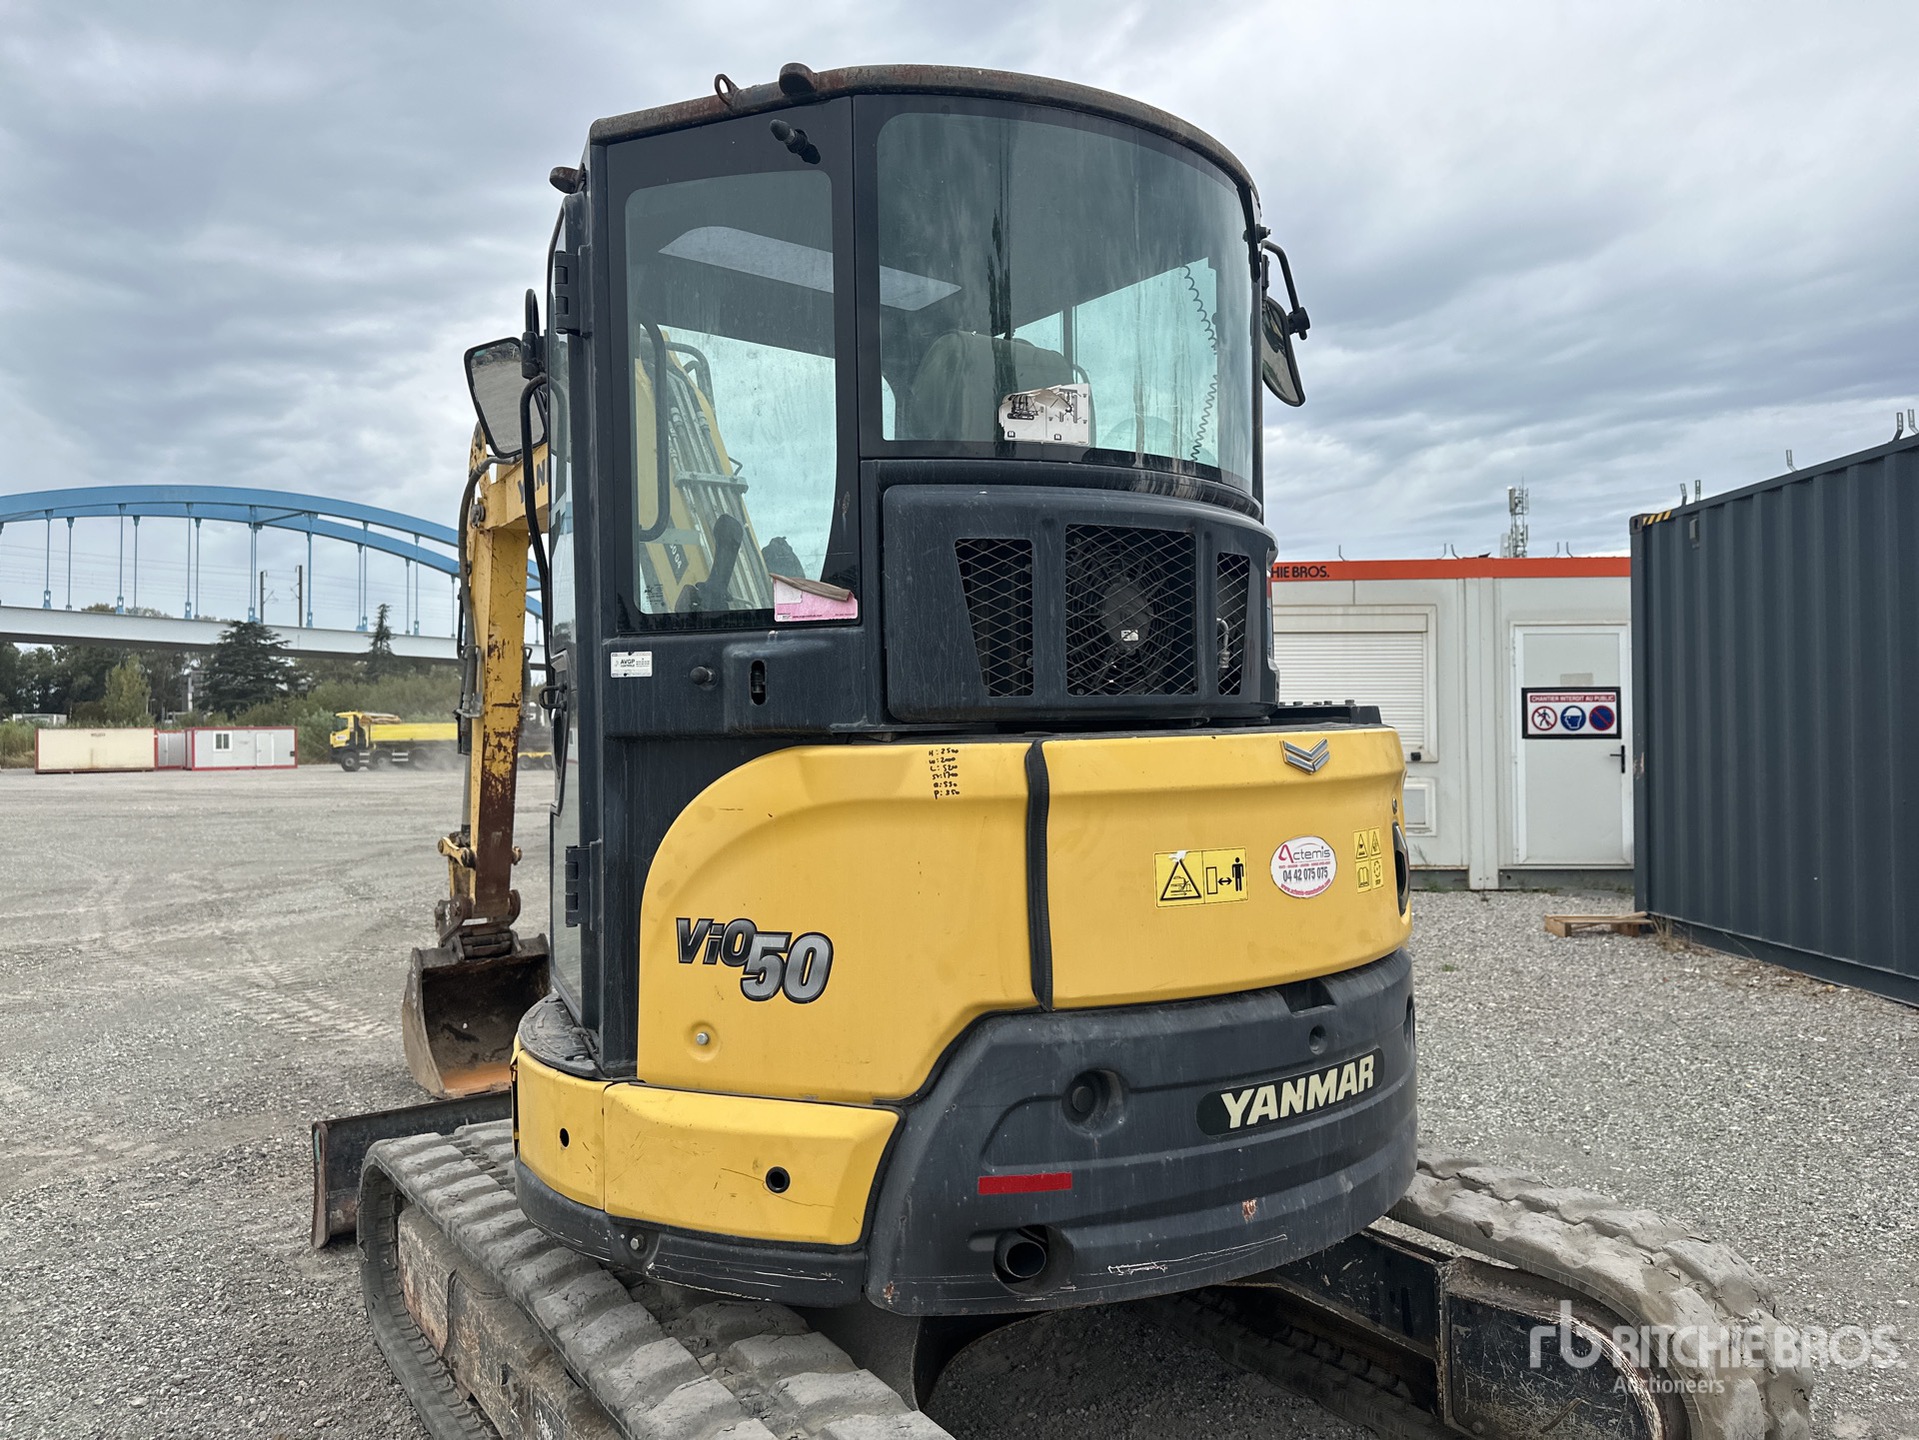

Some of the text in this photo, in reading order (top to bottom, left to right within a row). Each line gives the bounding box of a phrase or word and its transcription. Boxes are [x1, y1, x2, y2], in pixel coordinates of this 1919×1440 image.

[1271, 565, 1330, 578] HIE BROS.
[1594, 694, 1614, 702] PUBLIC
[1278, 844, 1331, 863] Actemis
[1282, 866, 1328, 882] 04 42 075 075
[1221, 1055, 1375, 1129] YANMAR
